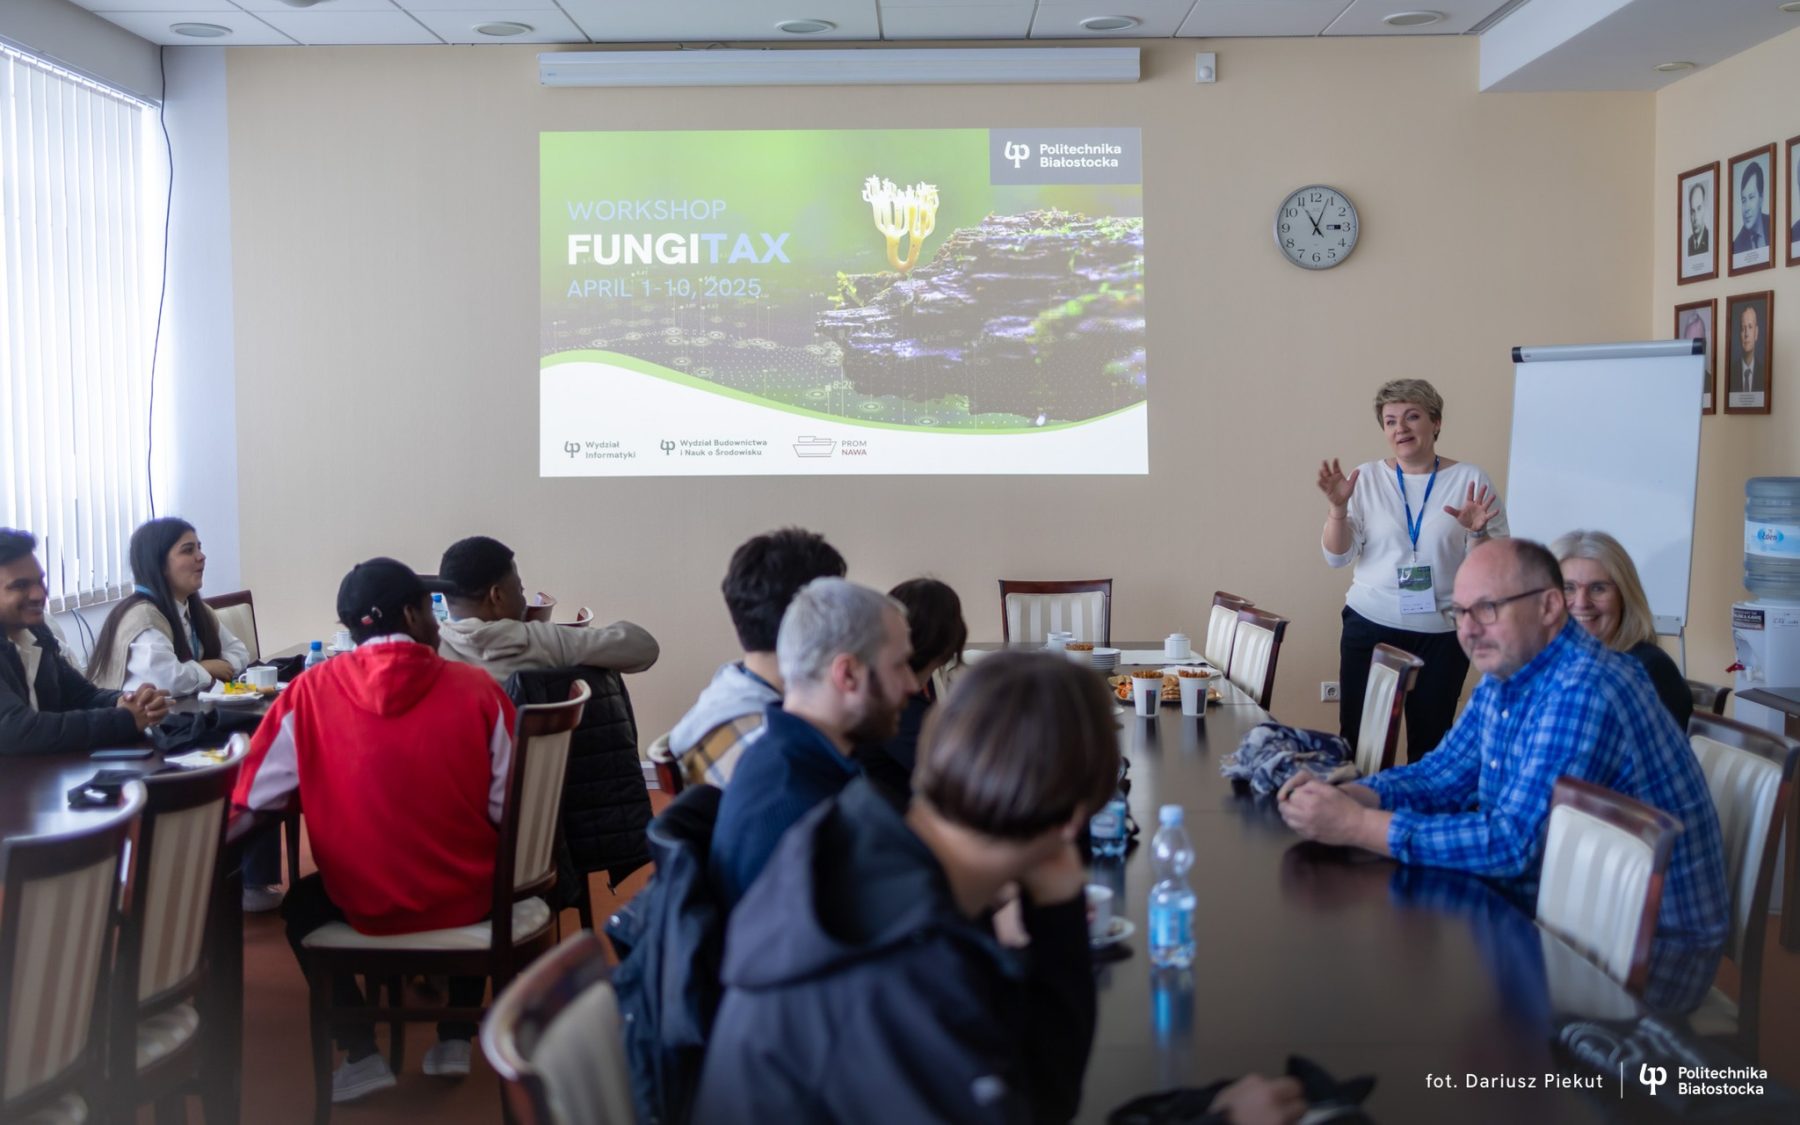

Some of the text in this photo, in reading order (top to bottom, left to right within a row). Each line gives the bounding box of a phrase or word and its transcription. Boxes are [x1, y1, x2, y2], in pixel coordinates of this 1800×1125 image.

[1039, 143, 1122, 155] Politechnika
[1039, 156, 1119, 168] Białostocka
[1297, 197, 1305, 207] 11
[1310, 192, 1322, 202] 12
[566, 199, 727, 221] WORKSHOP
[1285, 208, 1298, 218] 10
[1338, 207, 1346, 217] 2
[1281, 223, 1290, 233] 9
[1342, 222, 1351, 232] 3
[1286, 238, 1295, 248] 8
[1338, 238, 1346, 247] 4
[567, 232, 791, 265] FUNGITAX
[1328, 248, 1336, 258] 5
[1297, 249, 1305, 259] 7
[1312, 252, 1321, 262] 6
[567, 278, 761, 299] APRIL 1-10, 2025
[585, 440, 620, 449] Wydział
[680, 439, 712, 447] Wydział
[585, 451, 636, 460] Informatyki
[715, 448, 762, 456] Środowisku
